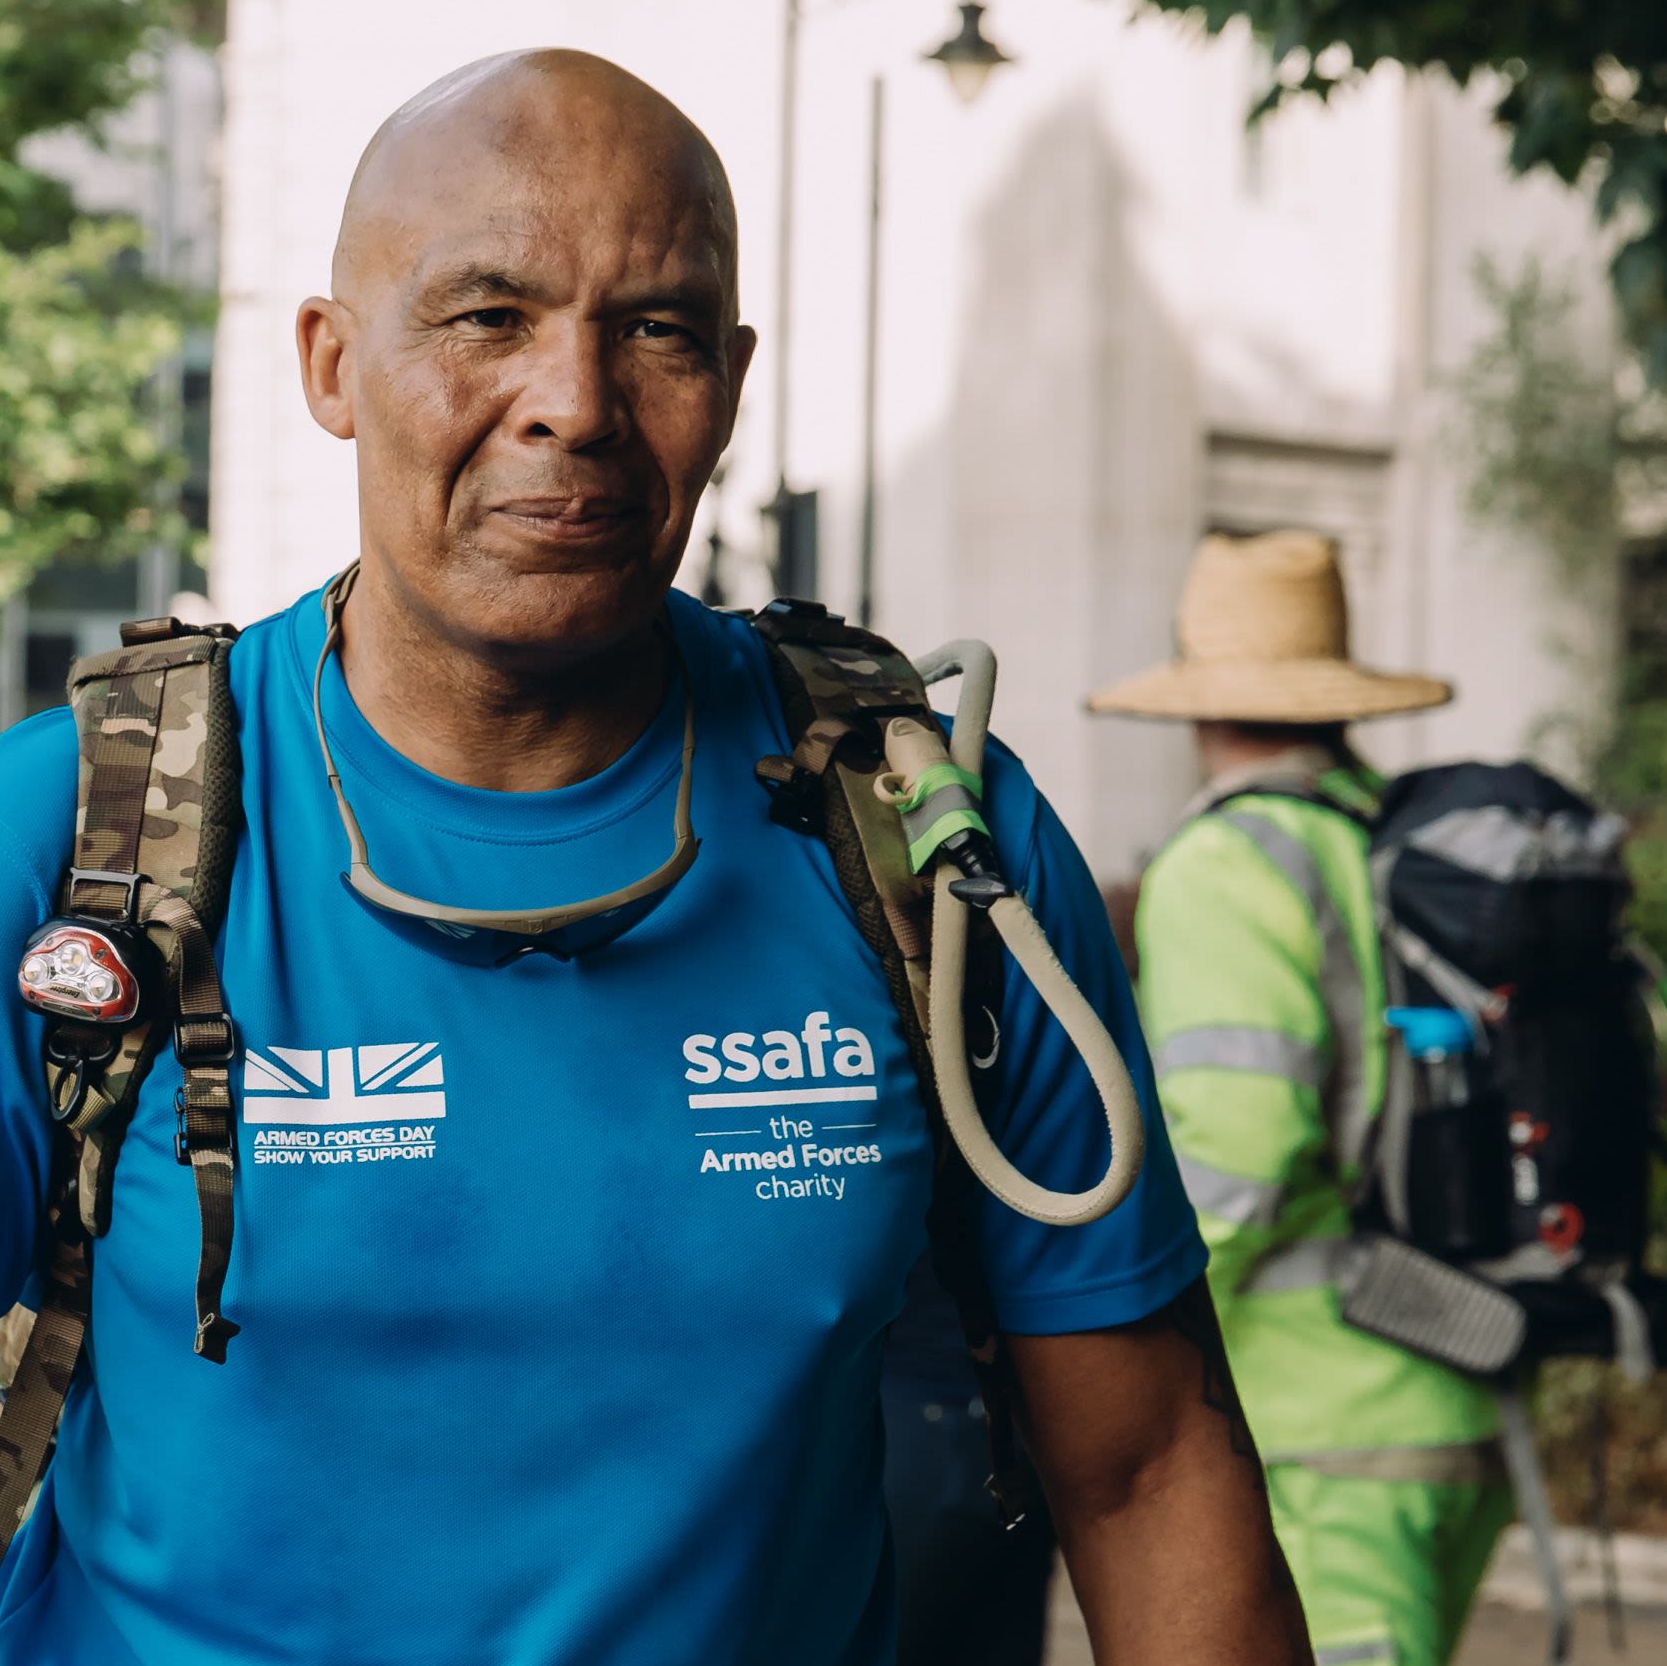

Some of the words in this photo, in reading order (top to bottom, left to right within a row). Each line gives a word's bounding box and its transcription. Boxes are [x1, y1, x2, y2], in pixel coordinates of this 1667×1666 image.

[682, 1011, 875, 1084] ssafa
[254, 1130, 320, 1147] ARMED
[323, 1127, 395, 1146] FORCES
[399, 1125, 435, 1141] DAY
[769, 1115, 813, 1140] the
[254, 1150, 305, 1164] SHOW
[308, 1149, 353, 1164] YOUR
[356, 1145, 436, 1163] SUPPORT
[700, 1144, 796, 1173] Armed
[802, 1142, 882, 1168] Forces
[755, 1174, 845, 1200] charity
